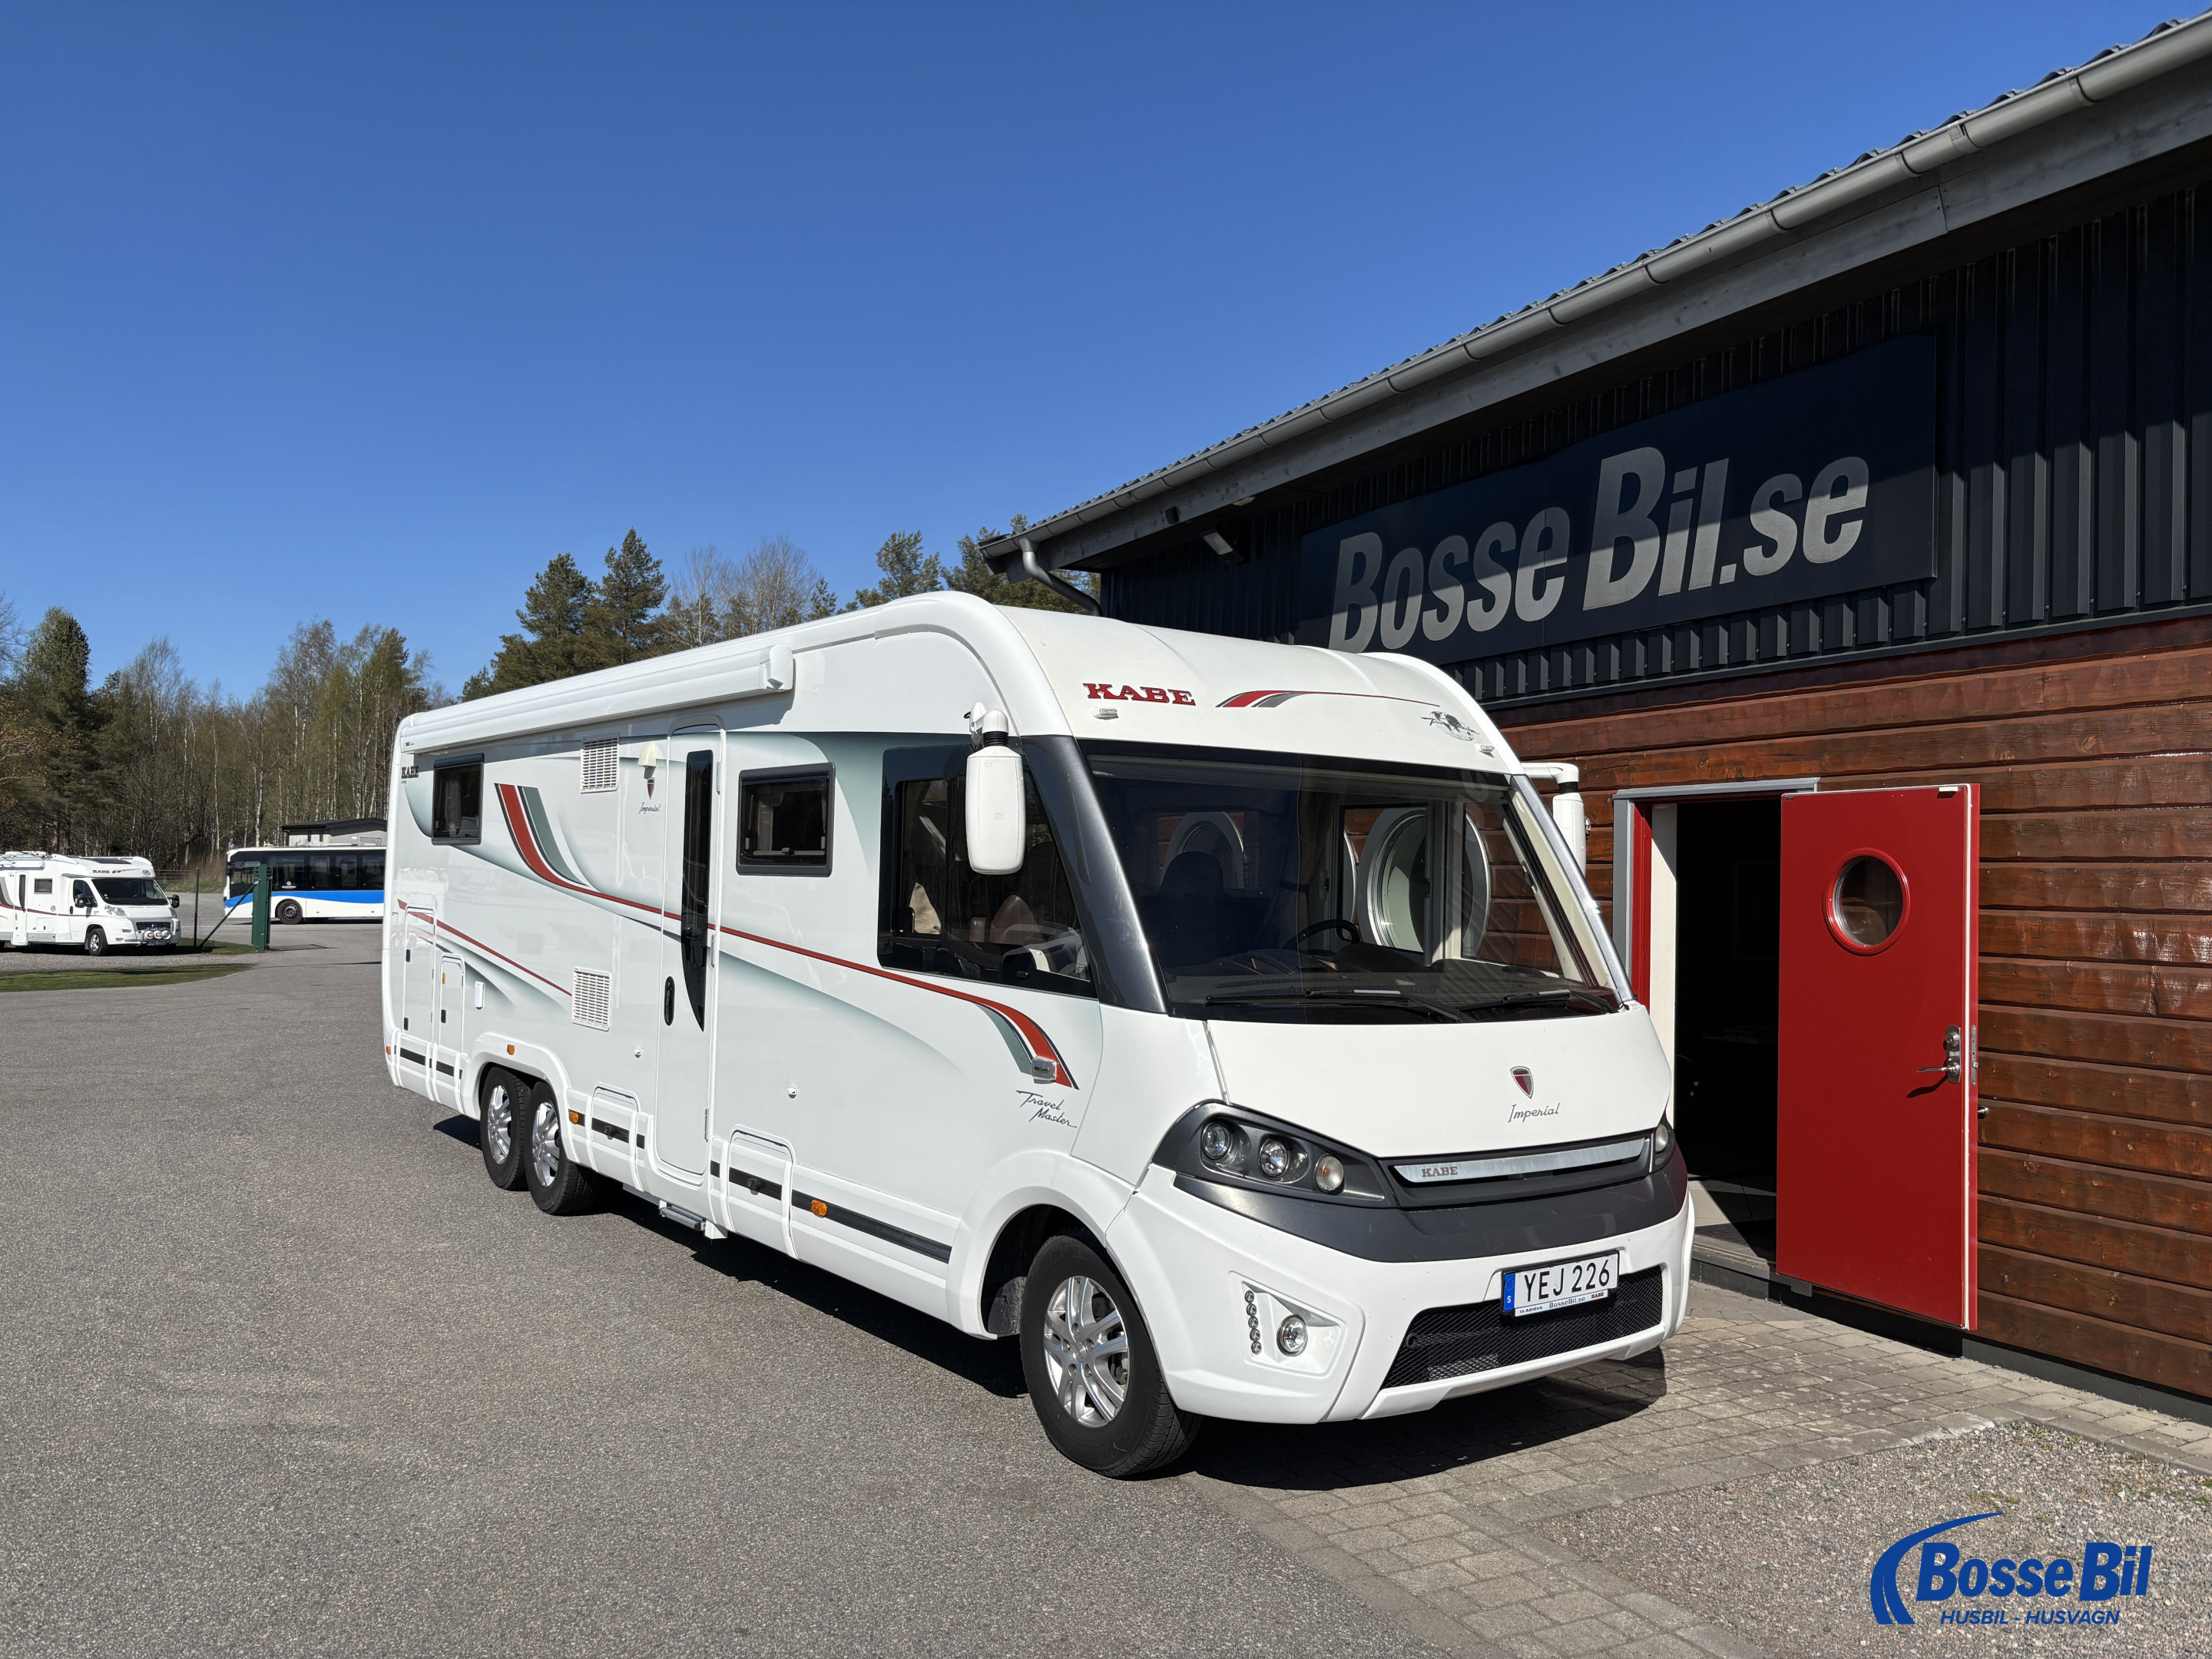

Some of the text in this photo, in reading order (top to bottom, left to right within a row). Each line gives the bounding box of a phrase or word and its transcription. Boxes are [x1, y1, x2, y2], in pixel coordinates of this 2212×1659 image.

[1329, 447, 1869, 654] Bosse Bil.se
[1082, 683, 1197, 707] KABE
[401, 766, 419, 779] KABE
[1015, 1090, 1065, 1111] Travel
[1028, 1107, 1078, 1129] Master
[1507, 1102, 1560, 1123] Imperial
[1421, 1166, 1458, 1177] KABE
[1524, 1259, 1610, 1303] YEJ 226
[1506, 1295, 1512, 1304] S
[1549, 1296, 1586, 1309] BosseBil.se
